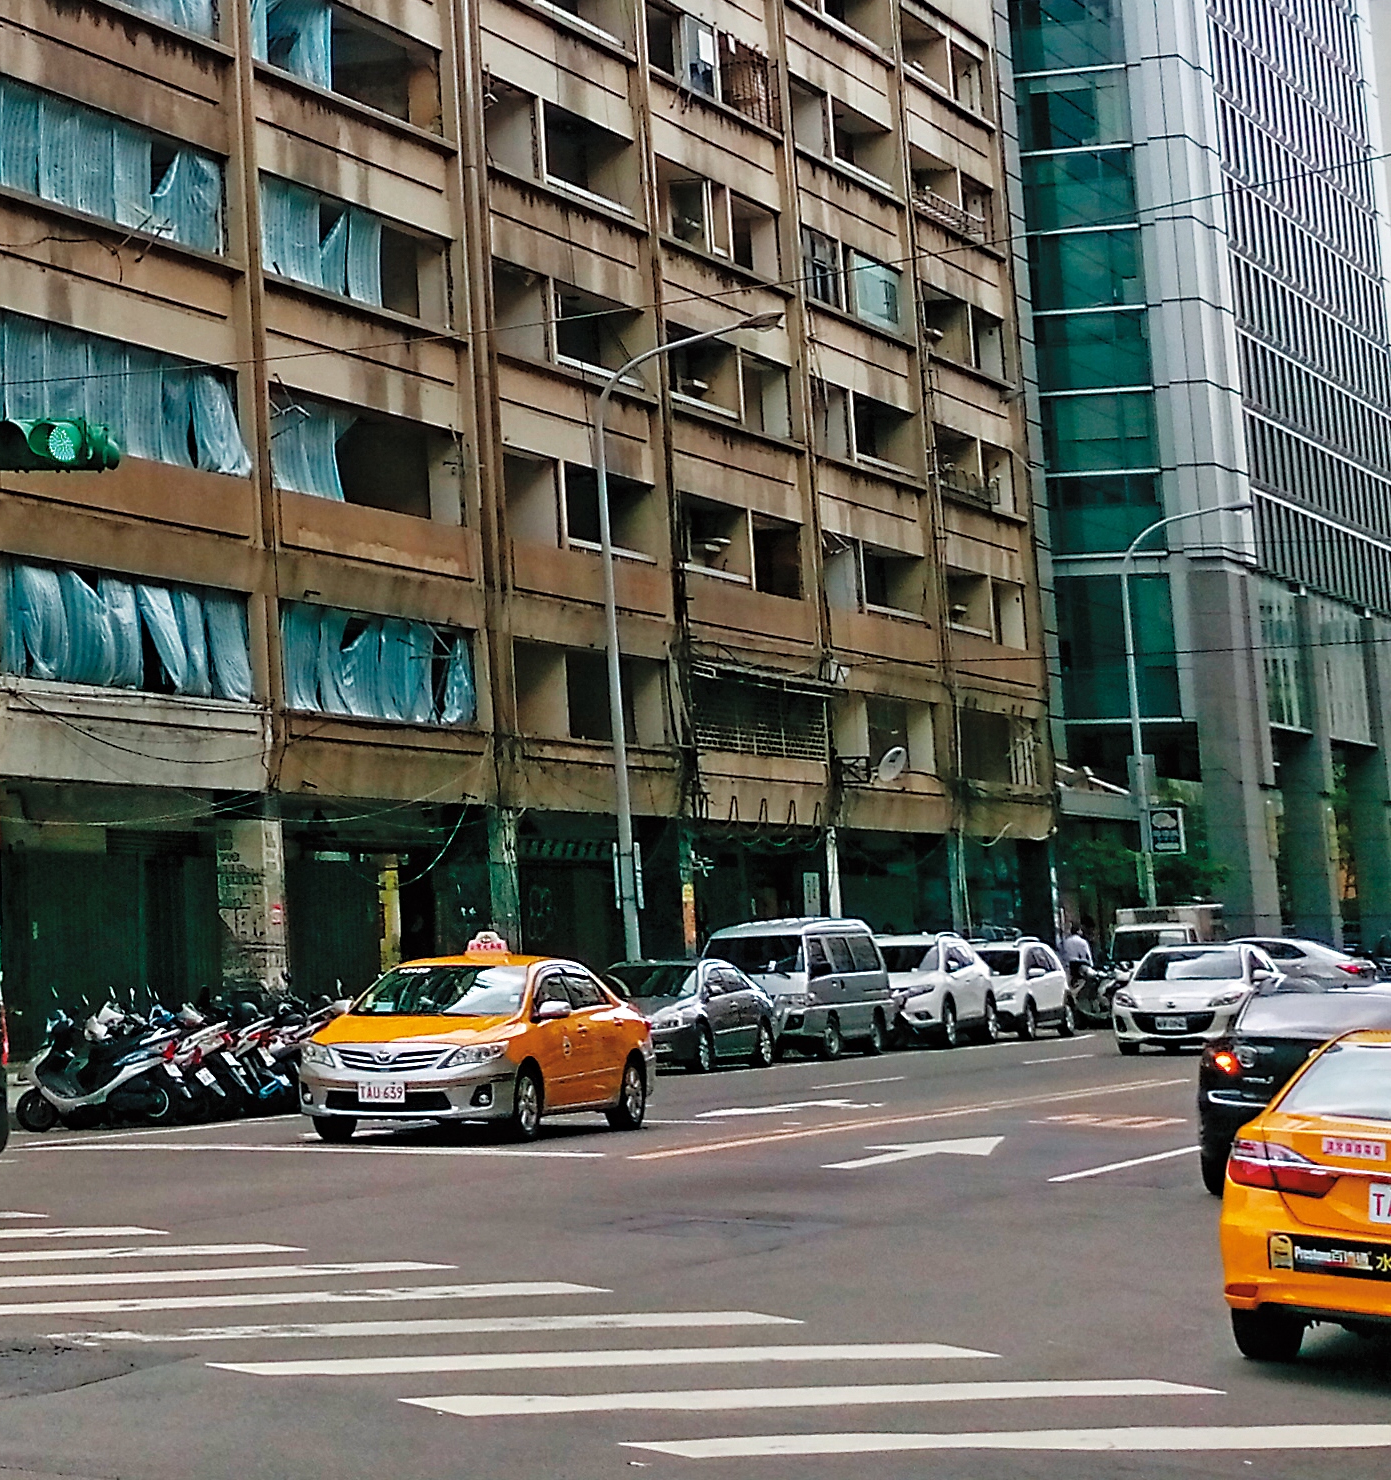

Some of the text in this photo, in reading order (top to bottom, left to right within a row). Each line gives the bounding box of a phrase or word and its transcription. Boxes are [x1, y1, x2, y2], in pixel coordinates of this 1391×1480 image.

[360, 1086, 403, 1099] TAU 639
[1372, 1192, 1391, 1217] T
